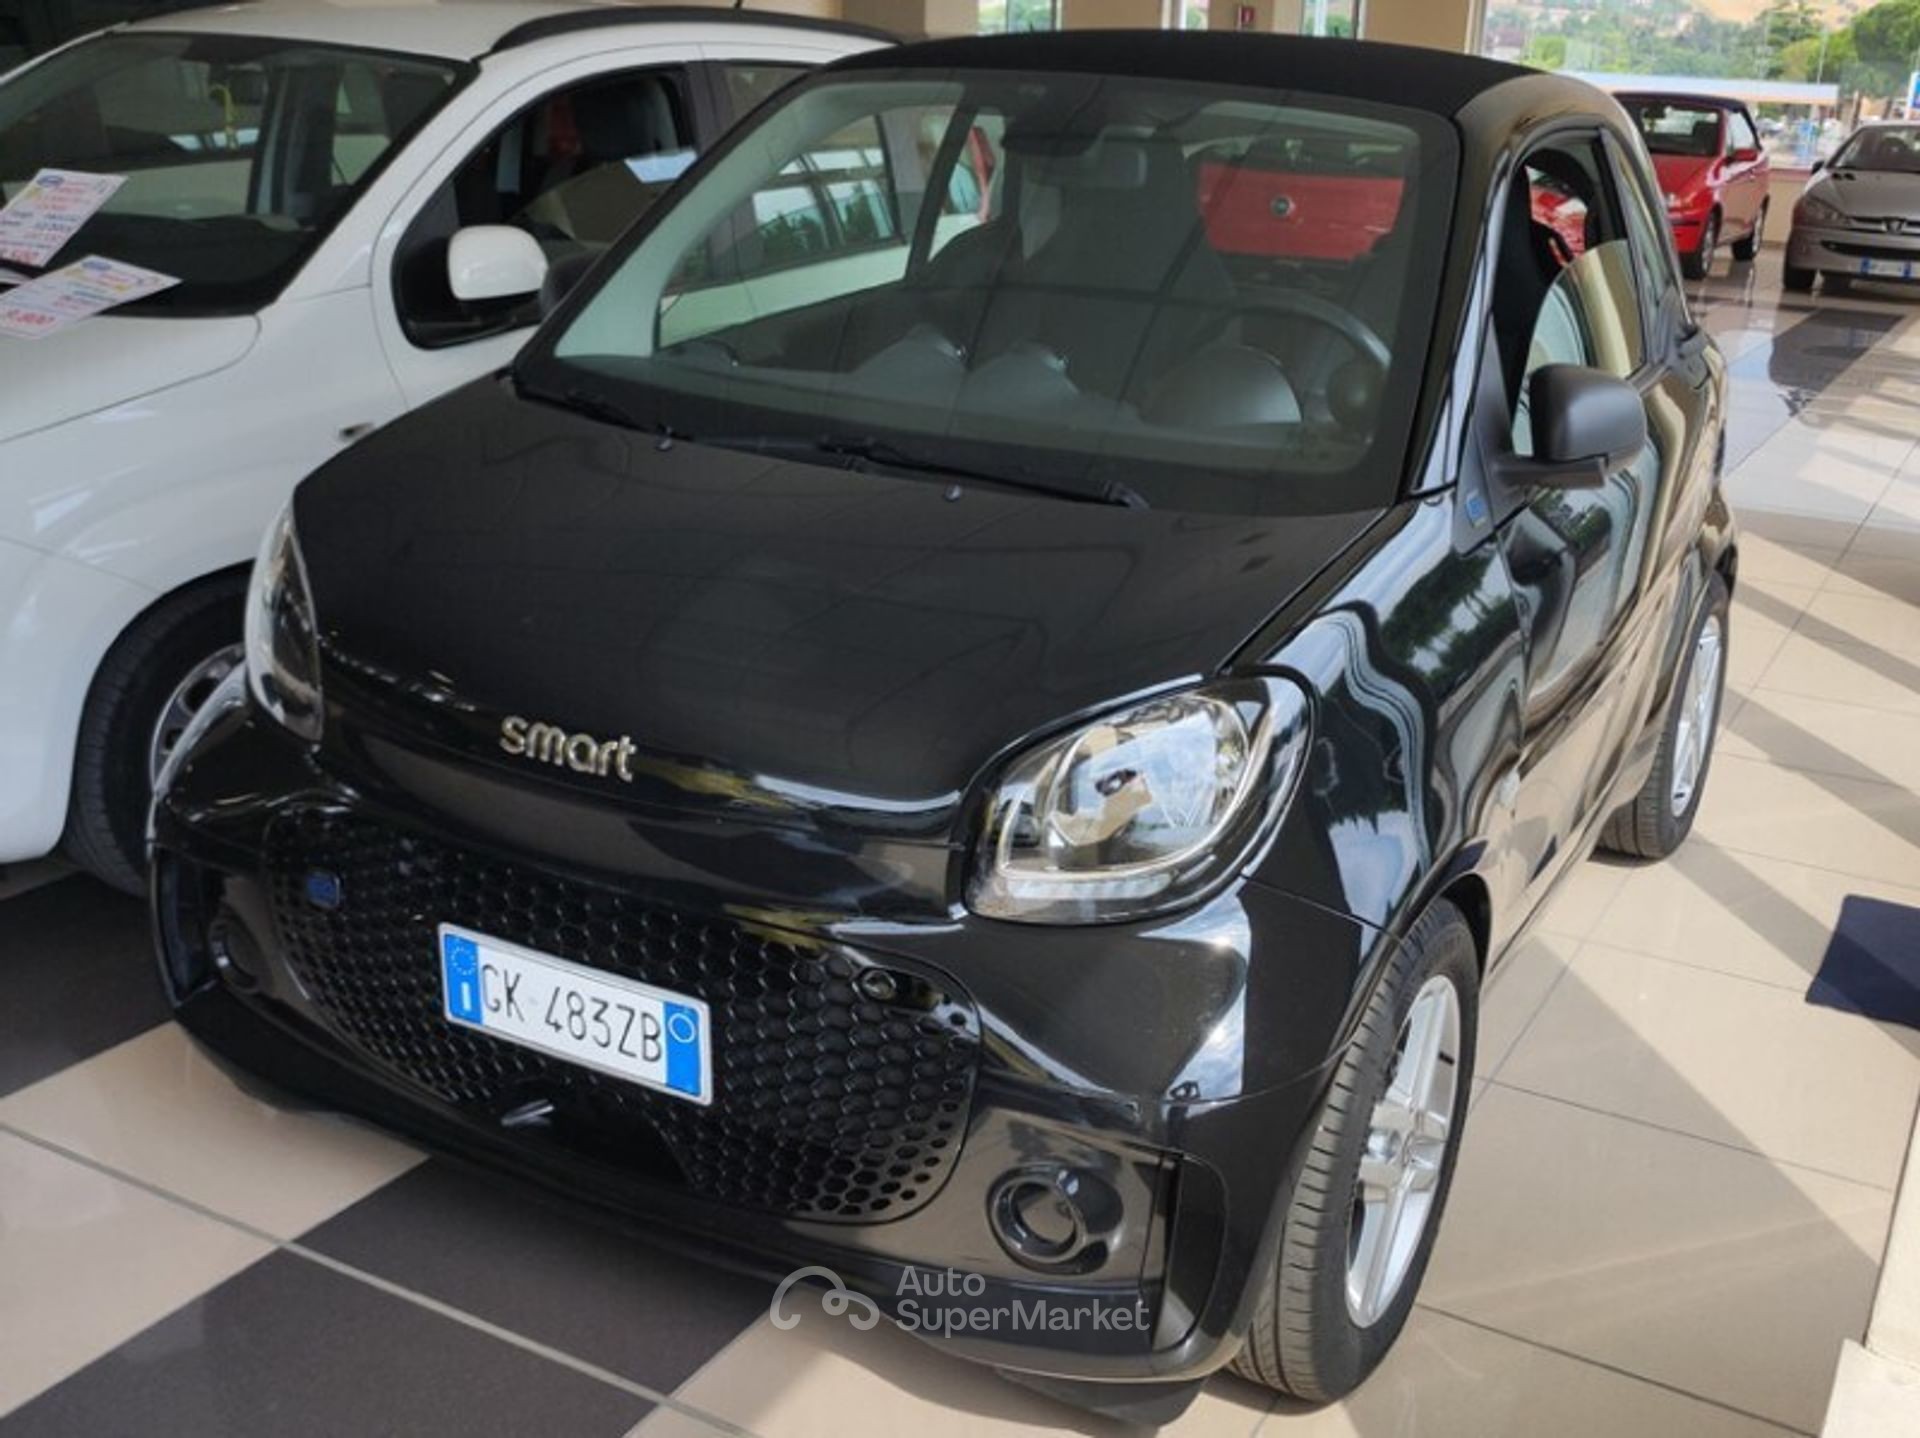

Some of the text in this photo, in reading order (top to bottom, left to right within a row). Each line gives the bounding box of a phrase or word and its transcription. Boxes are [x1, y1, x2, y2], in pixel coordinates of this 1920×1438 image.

[499, 715, 638, 783] smart
[481, 963, 663, 1063] GK 483ZB
